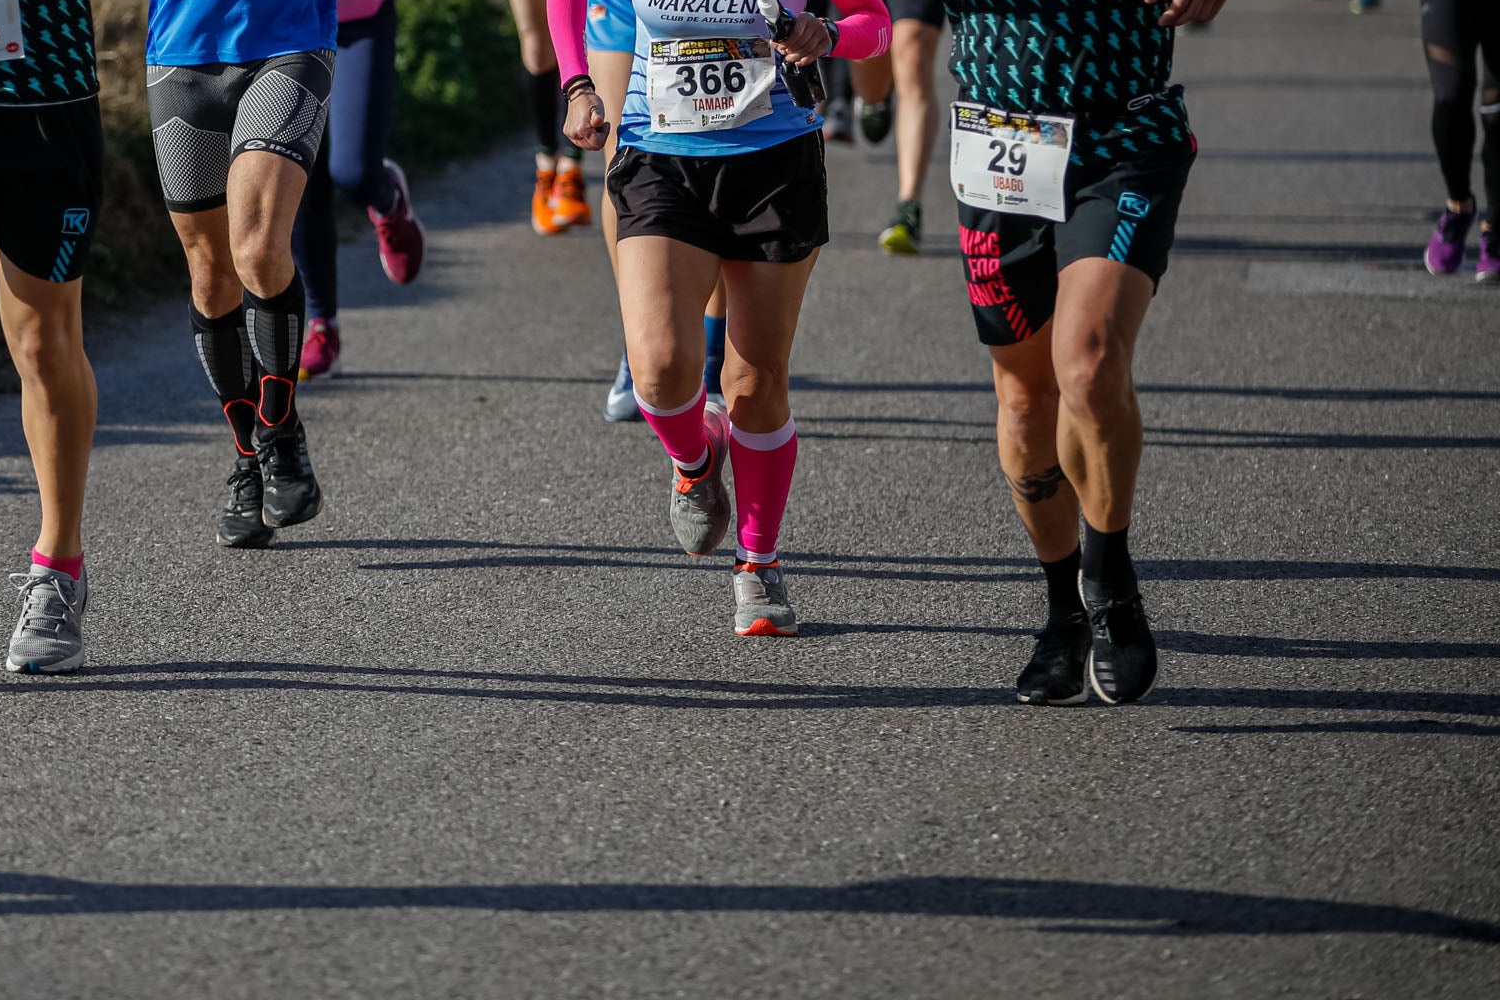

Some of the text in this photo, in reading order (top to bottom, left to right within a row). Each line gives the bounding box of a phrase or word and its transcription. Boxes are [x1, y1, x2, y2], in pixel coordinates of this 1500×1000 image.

[661, 14, 684, 22] CLUB
[679, 47, 725, 55] POPULAR
[675, 62, 746, 97] 366
[692, 96, 735, 112] TAMARA
[711, 113, 735, 121] olimpo
[987, 139, 1027, 176] 29
[993, 175, 1024, 192] UBAGO
